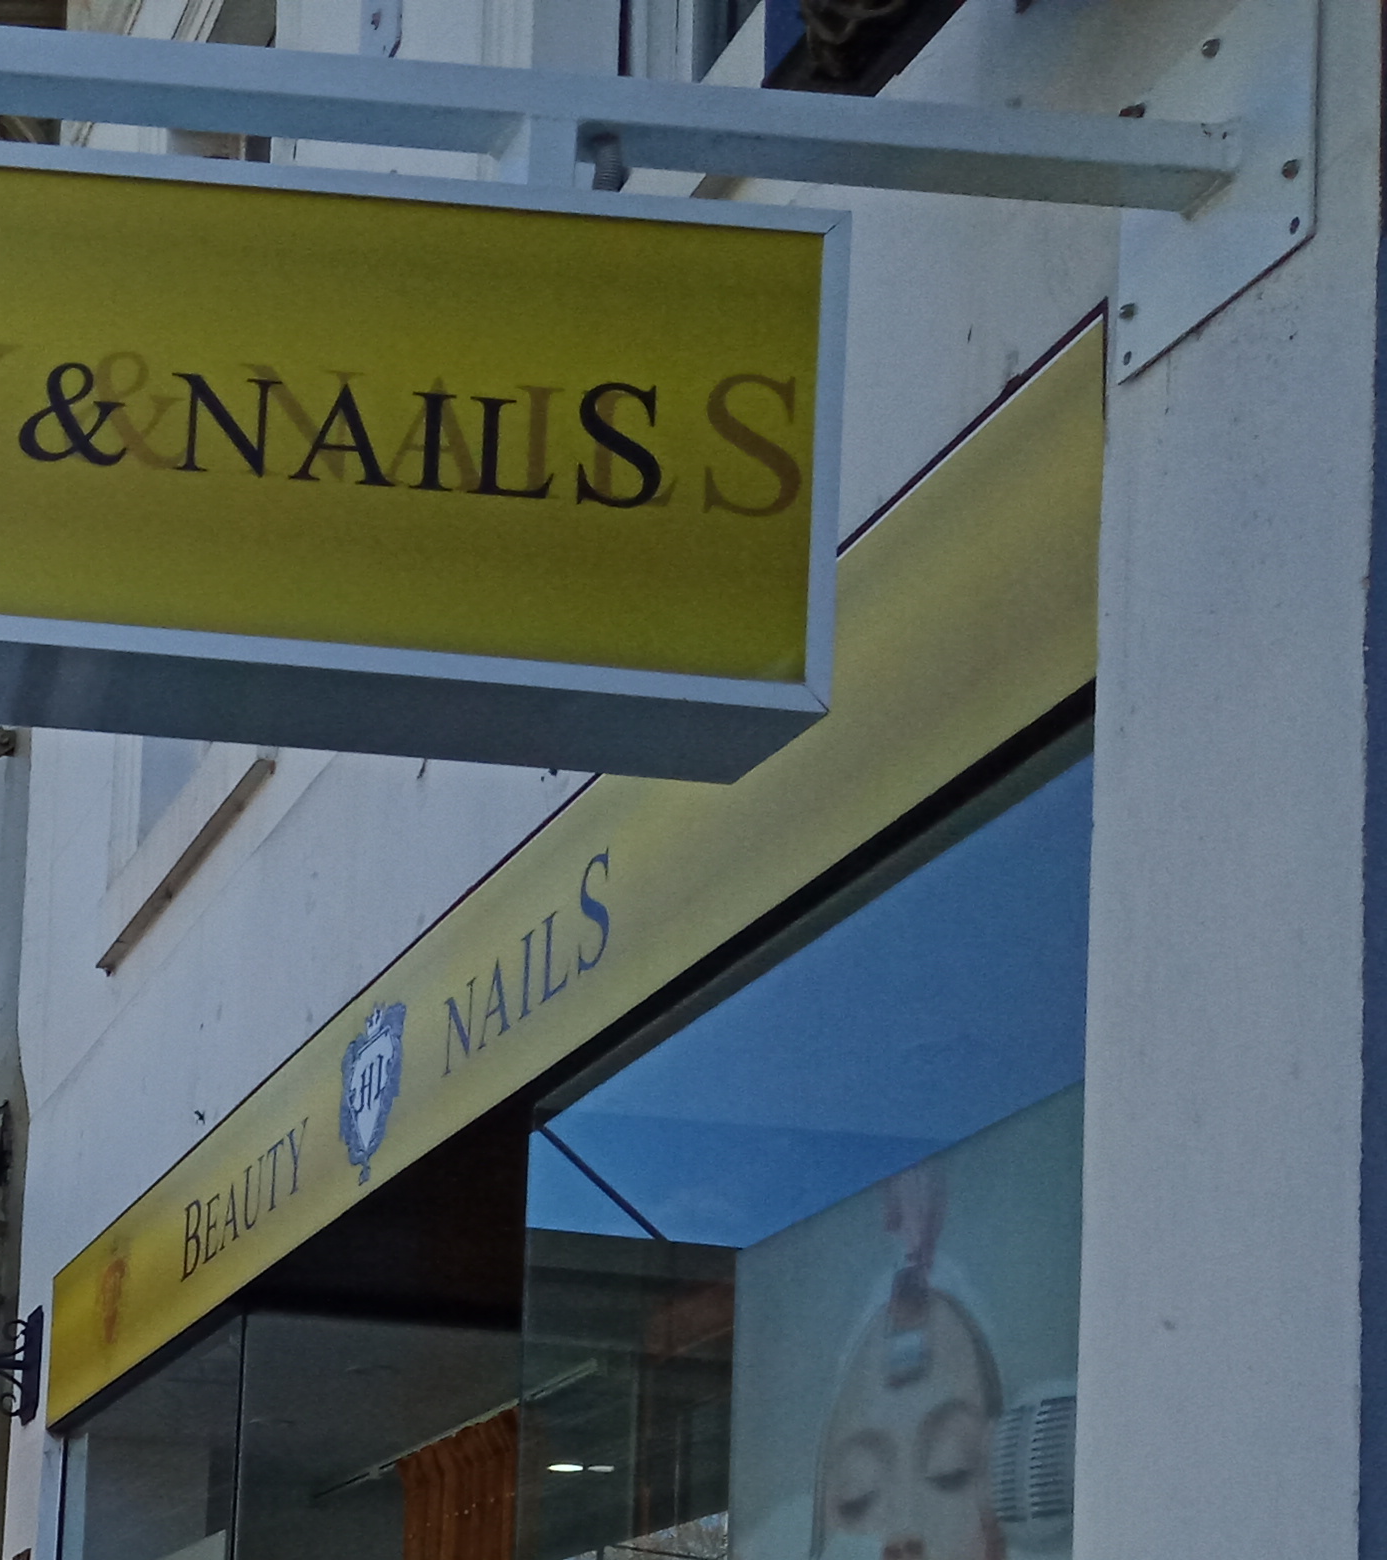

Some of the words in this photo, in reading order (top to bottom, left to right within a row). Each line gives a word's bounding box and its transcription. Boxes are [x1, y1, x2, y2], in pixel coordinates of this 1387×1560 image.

[18, 362, 128, 466] &
[172, 371, 665, 508] NAILS
[180, 1117, 309, 1282] BEAUTY
[442, 846, 610, 1078] NAILS
